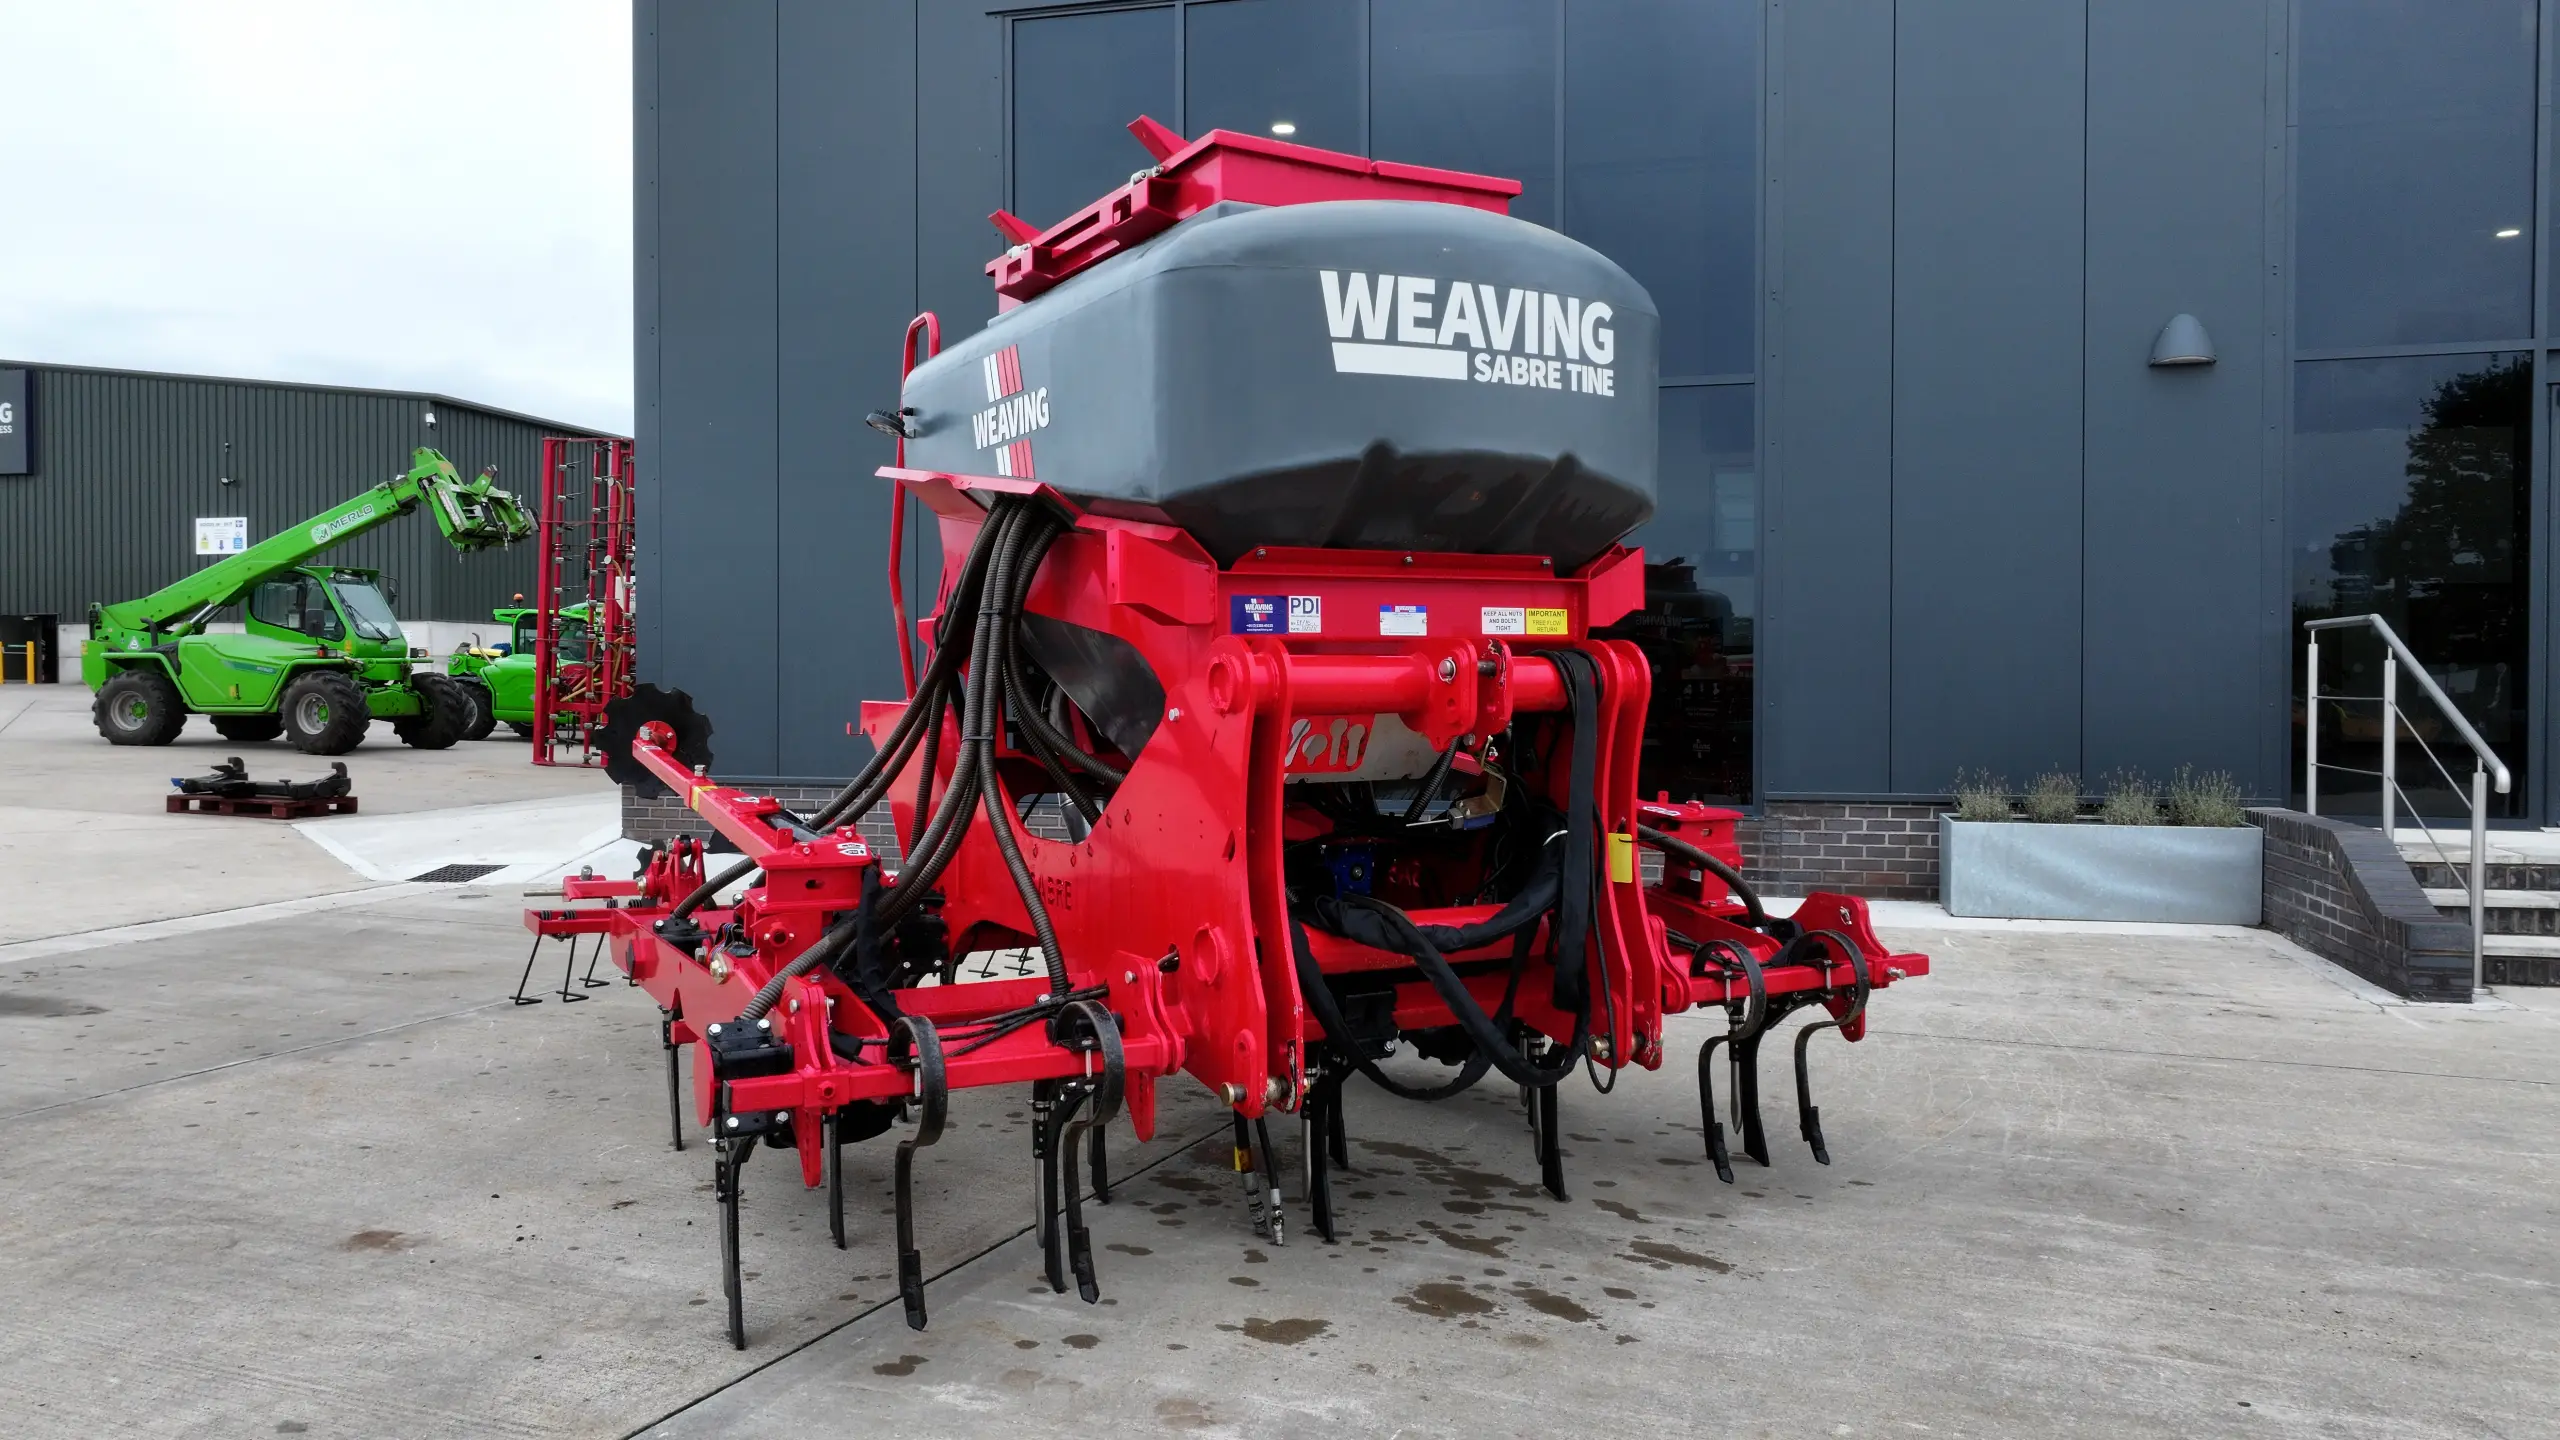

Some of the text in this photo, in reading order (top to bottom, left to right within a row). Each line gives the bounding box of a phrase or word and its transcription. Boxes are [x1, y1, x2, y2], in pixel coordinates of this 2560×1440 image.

[1320, 270, 1615, 365] WEAVING
[1474, 352, 1615, 397] SABRE TINE
[972, 386, 1050, 451] WEAVING
[330, 505, 373, 530] MERLO
[1291, 598, 1319, 614] PDI
[1031, 872, 1071, 911] ABRE
